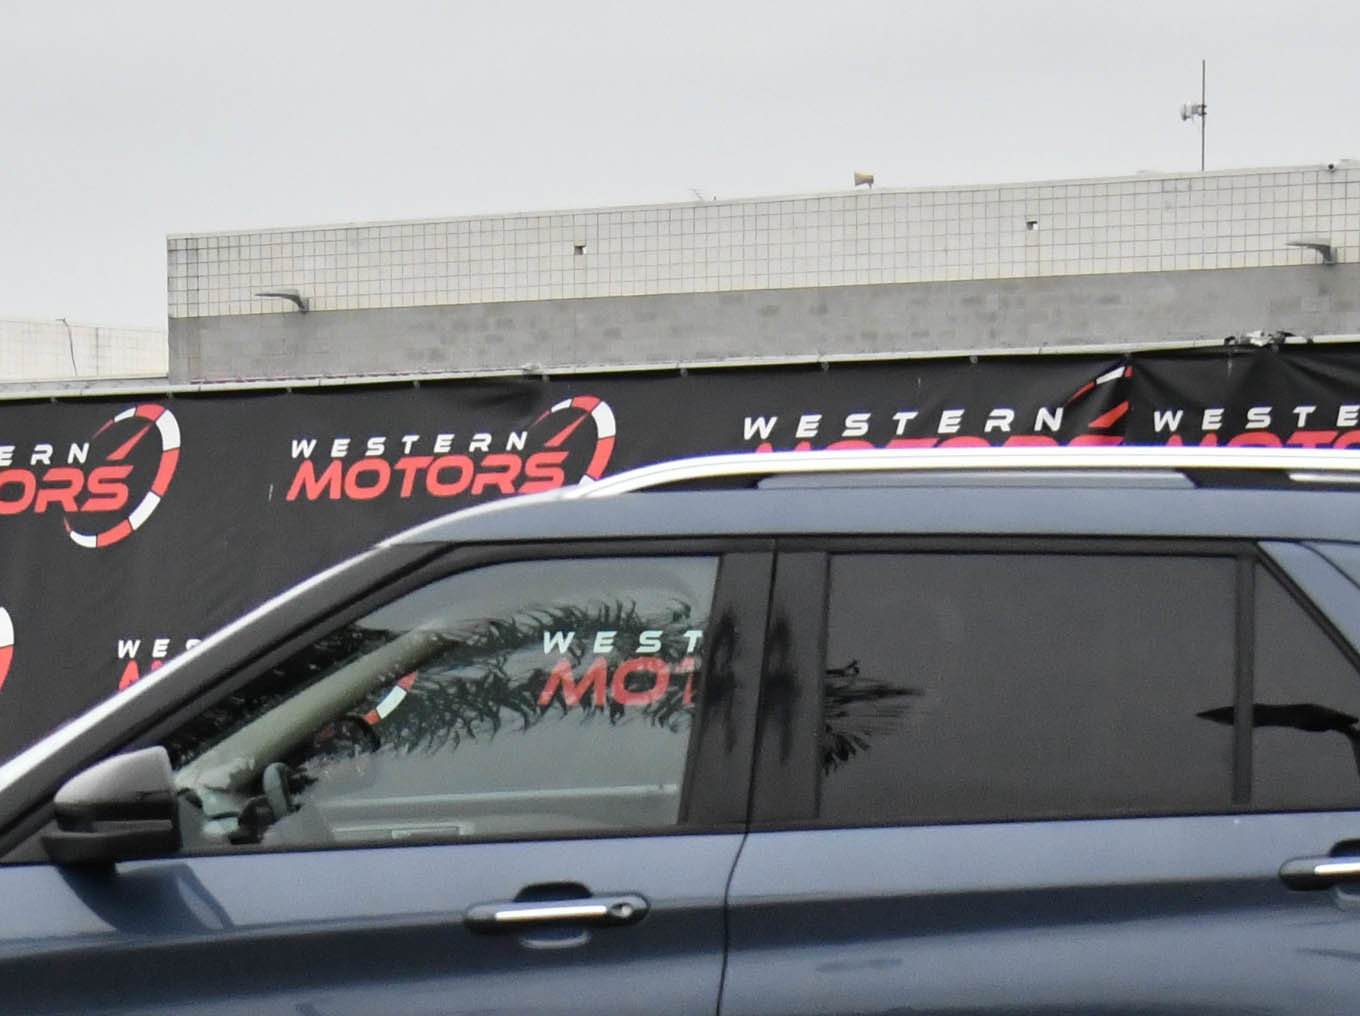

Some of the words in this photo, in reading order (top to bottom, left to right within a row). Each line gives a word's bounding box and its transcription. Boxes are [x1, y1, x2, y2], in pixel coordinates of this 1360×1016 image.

[743, 406, 1064, 441] WESTERN
[291, 430, 528, 459] WESTERN
[286, 450, 569, 500] MOTORS
